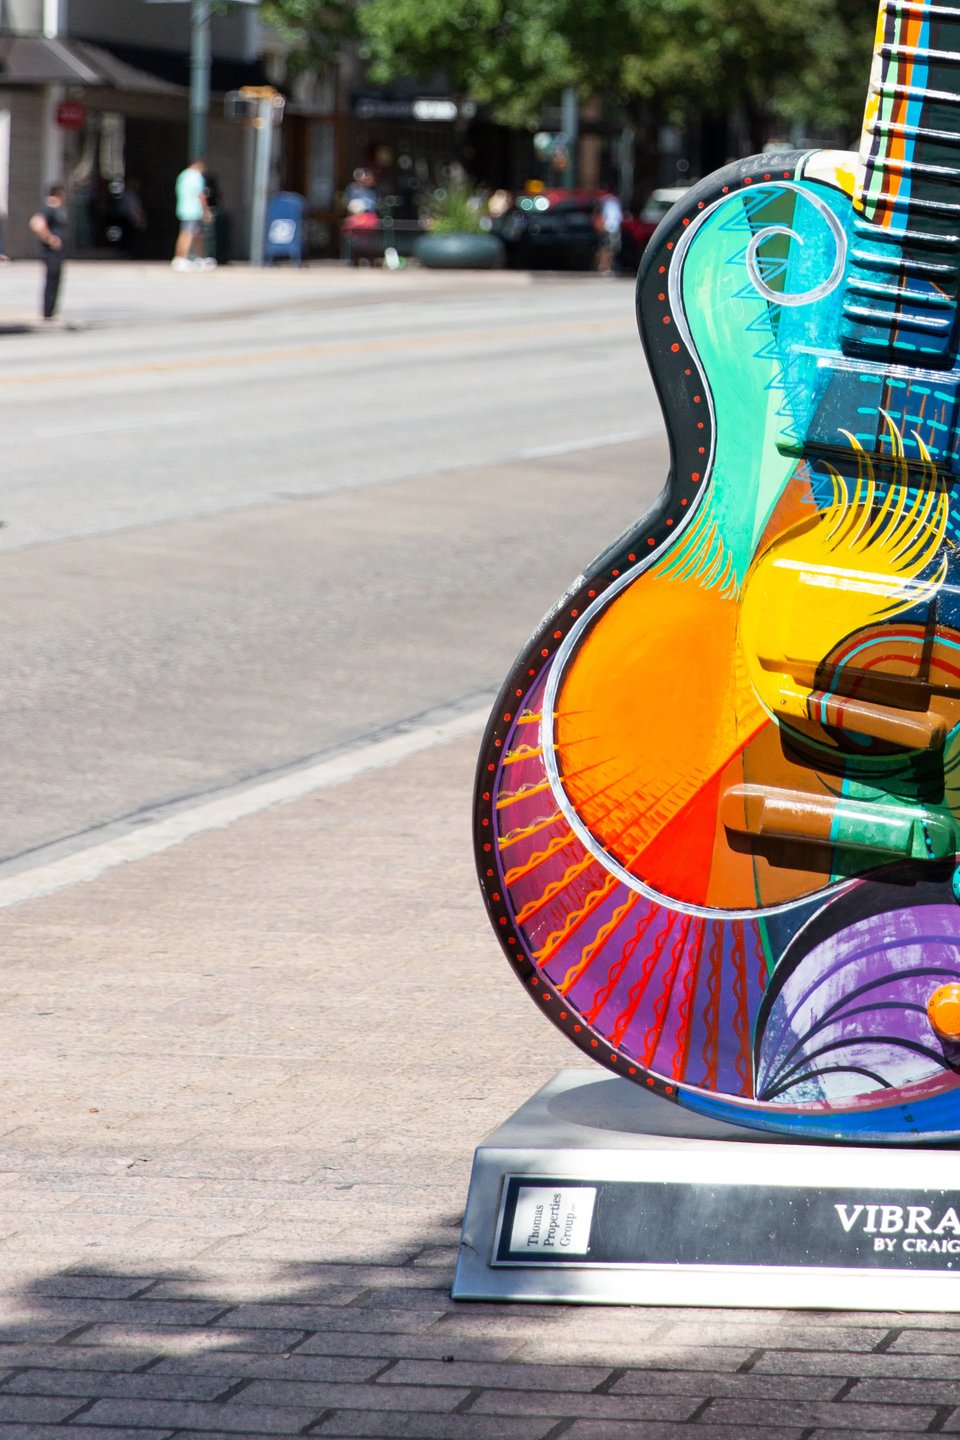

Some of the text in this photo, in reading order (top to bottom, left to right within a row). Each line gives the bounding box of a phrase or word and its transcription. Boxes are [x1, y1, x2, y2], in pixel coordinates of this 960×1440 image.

[526, 1204, 544, 1247] Thomas
[543, 1193, 562, 1247] Properties
[560, 1212, 577, 1247] Group
[873, 1237, 897, 1252] BY
